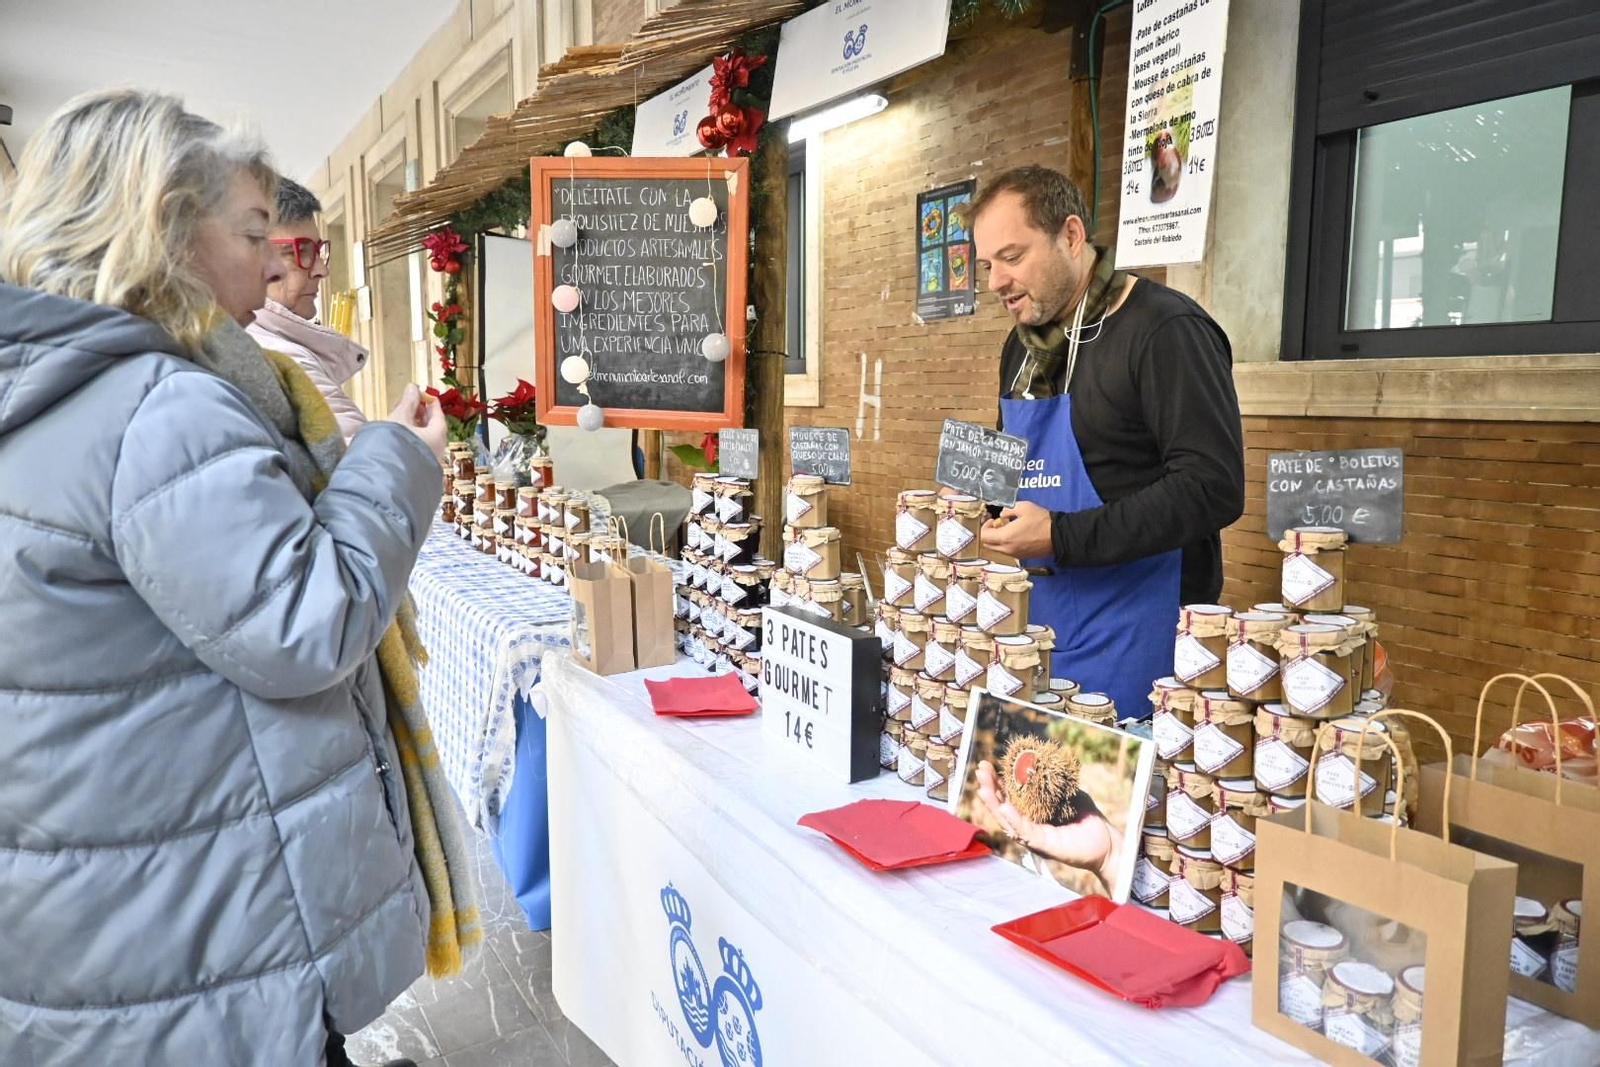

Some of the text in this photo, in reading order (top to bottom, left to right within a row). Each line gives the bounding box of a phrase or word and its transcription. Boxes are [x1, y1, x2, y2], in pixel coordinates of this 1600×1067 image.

[1153, 20, 1162, 31] de
[1163, 0, 1198, 26] castañas
[1134, 28, 1180, 61] jamón ibérico
[1133, 43, 1181, 77] (base vegetal)
[1160, 68, 1169, 79] de
[1170, 51, 1206, 74] castañas
[1131, 67, 1212, 108] con queso de cabra de
[1130, 107, 1158, 124] la Sierra
[1169, 115, 1178, 127] de
[1180, 110, 1196, 124] vino
[1128, 145, 1143, 157] tinto
[675, 188, 692, 207] LA
[643, 212, 661, 231] DE
[594, 289, 619, 311] LOS
[623, 289, 691, 313] MEJORES
[560, 312, 709, 333] INGREDIENTES PARA
[594, 334, 673, 355] EXPERIENCIA
[823, 442, 838, 450] CON
[827, 432, 838, 442] DE
[968, 430, 980, 443] DE
[981, 435, 1025, 457] CASTAÑAS
[956, 441, 982, 457] JAMÓN
[984, 449, 1024, 470] IBÉRICO
[1270, 453, 1400, 475] PATÉ DE BOLETUS
[1019, 459, 1061, 488] ea uelva
[1270, 474, 1398, 493] CON CASTAÑAS
[1352, 507, 1370, 523] €
[766, 619, 828, 669] 3 PATES
[764, 659, 833, 716] GOURMET
[785, 711, 814, 749] 14€
[650, 988, 704, 1067] DIPUTACI
